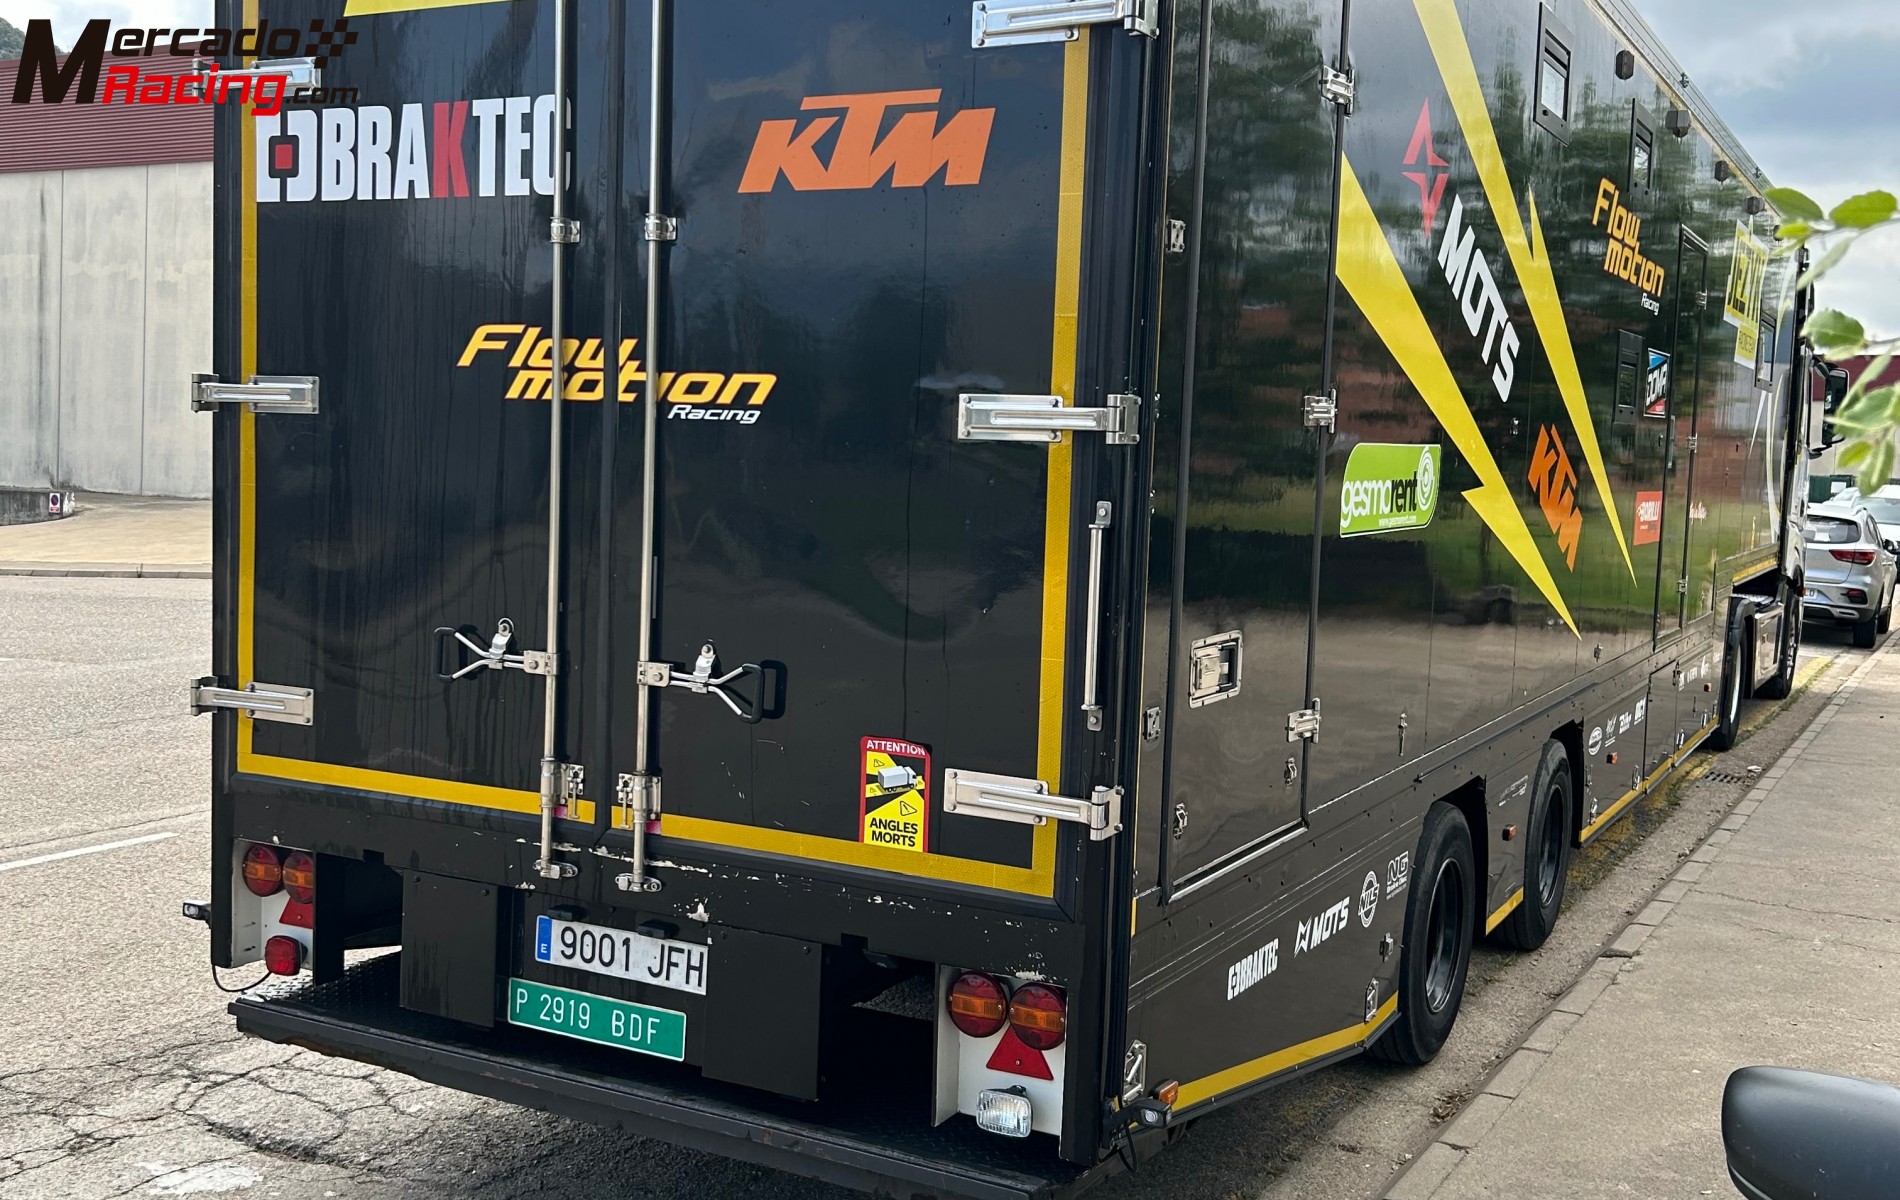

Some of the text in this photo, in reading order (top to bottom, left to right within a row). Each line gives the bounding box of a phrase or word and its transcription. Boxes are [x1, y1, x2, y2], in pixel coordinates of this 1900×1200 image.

[738, 88, 996, 193] KTM
[1592, 176, 1641, 248] Flow
[1604, 238, 1665, 298] motion
[1437, 193, 1520, 403] MOTS
[1641, 292, 1660, 316] Racing
[667, 404, 761, 424] Racing
[1340, 471, 1418, 528] gesmorent
[1528, 423, 1583, 573] KTM
[866, 739, 926, 756] ATTENTION
[869, 817, 918, 834] ANGLES
[871, 830, 916, 847] MORTS
[1387, 850, 1409, 886] NG
[540, 943, 548, 954] E
[1310, 896, 1351, 950] MOTS
[560, 926, 705, 988] 9001 JFH
[516, 988, 660, 1044] P 2919 BDF
